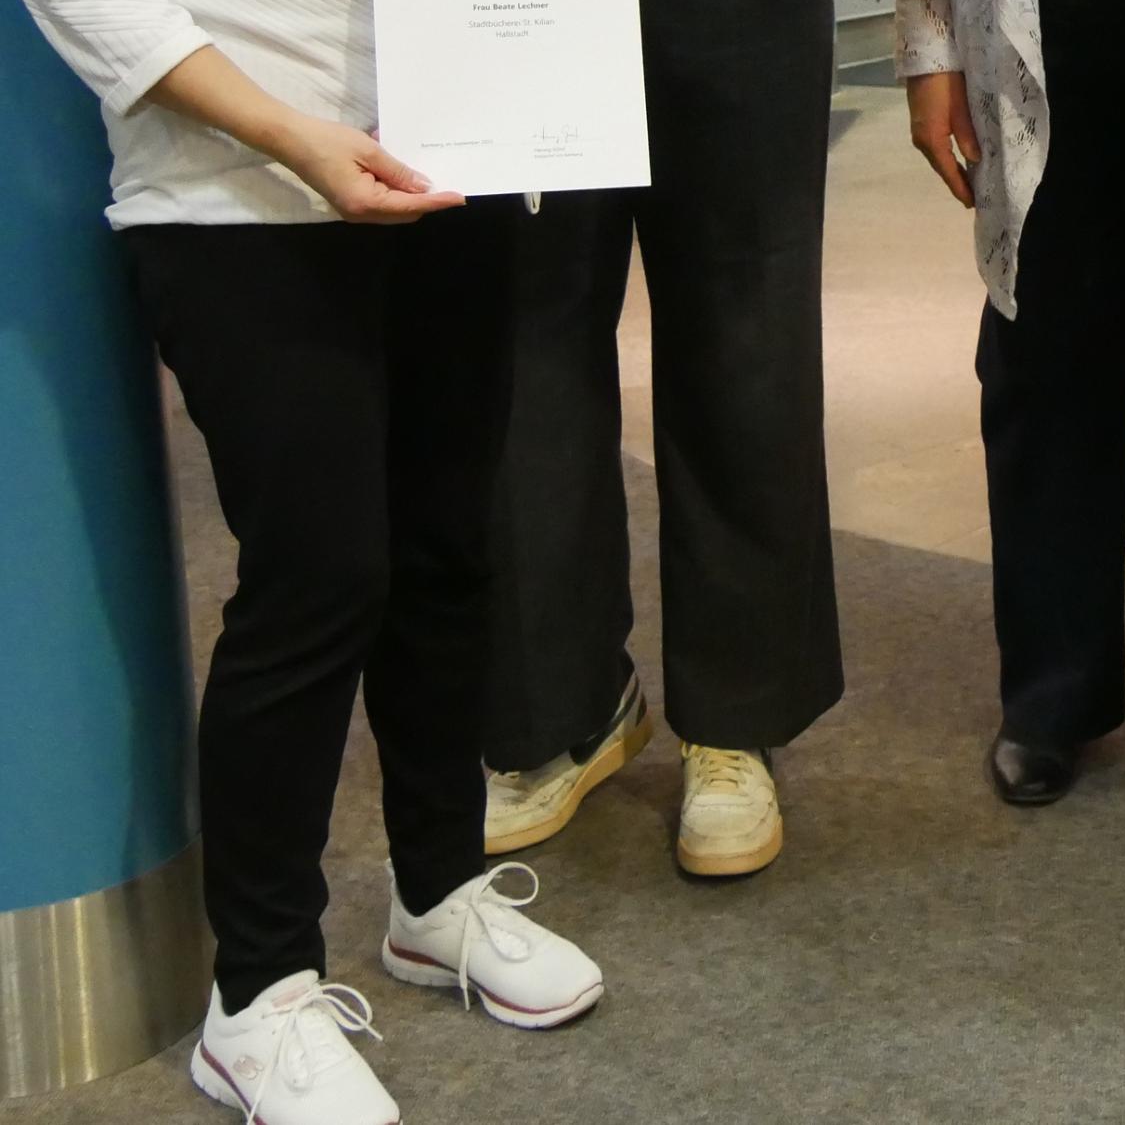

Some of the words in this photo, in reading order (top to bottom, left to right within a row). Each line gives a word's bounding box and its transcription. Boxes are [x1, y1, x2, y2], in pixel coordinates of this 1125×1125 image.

[472, 3, 491, 11] Frau
[493, 3, 516, 11] Beate
[517, 2, 550, 10] Lechner
[534, 18, 555, 26] Kilian
